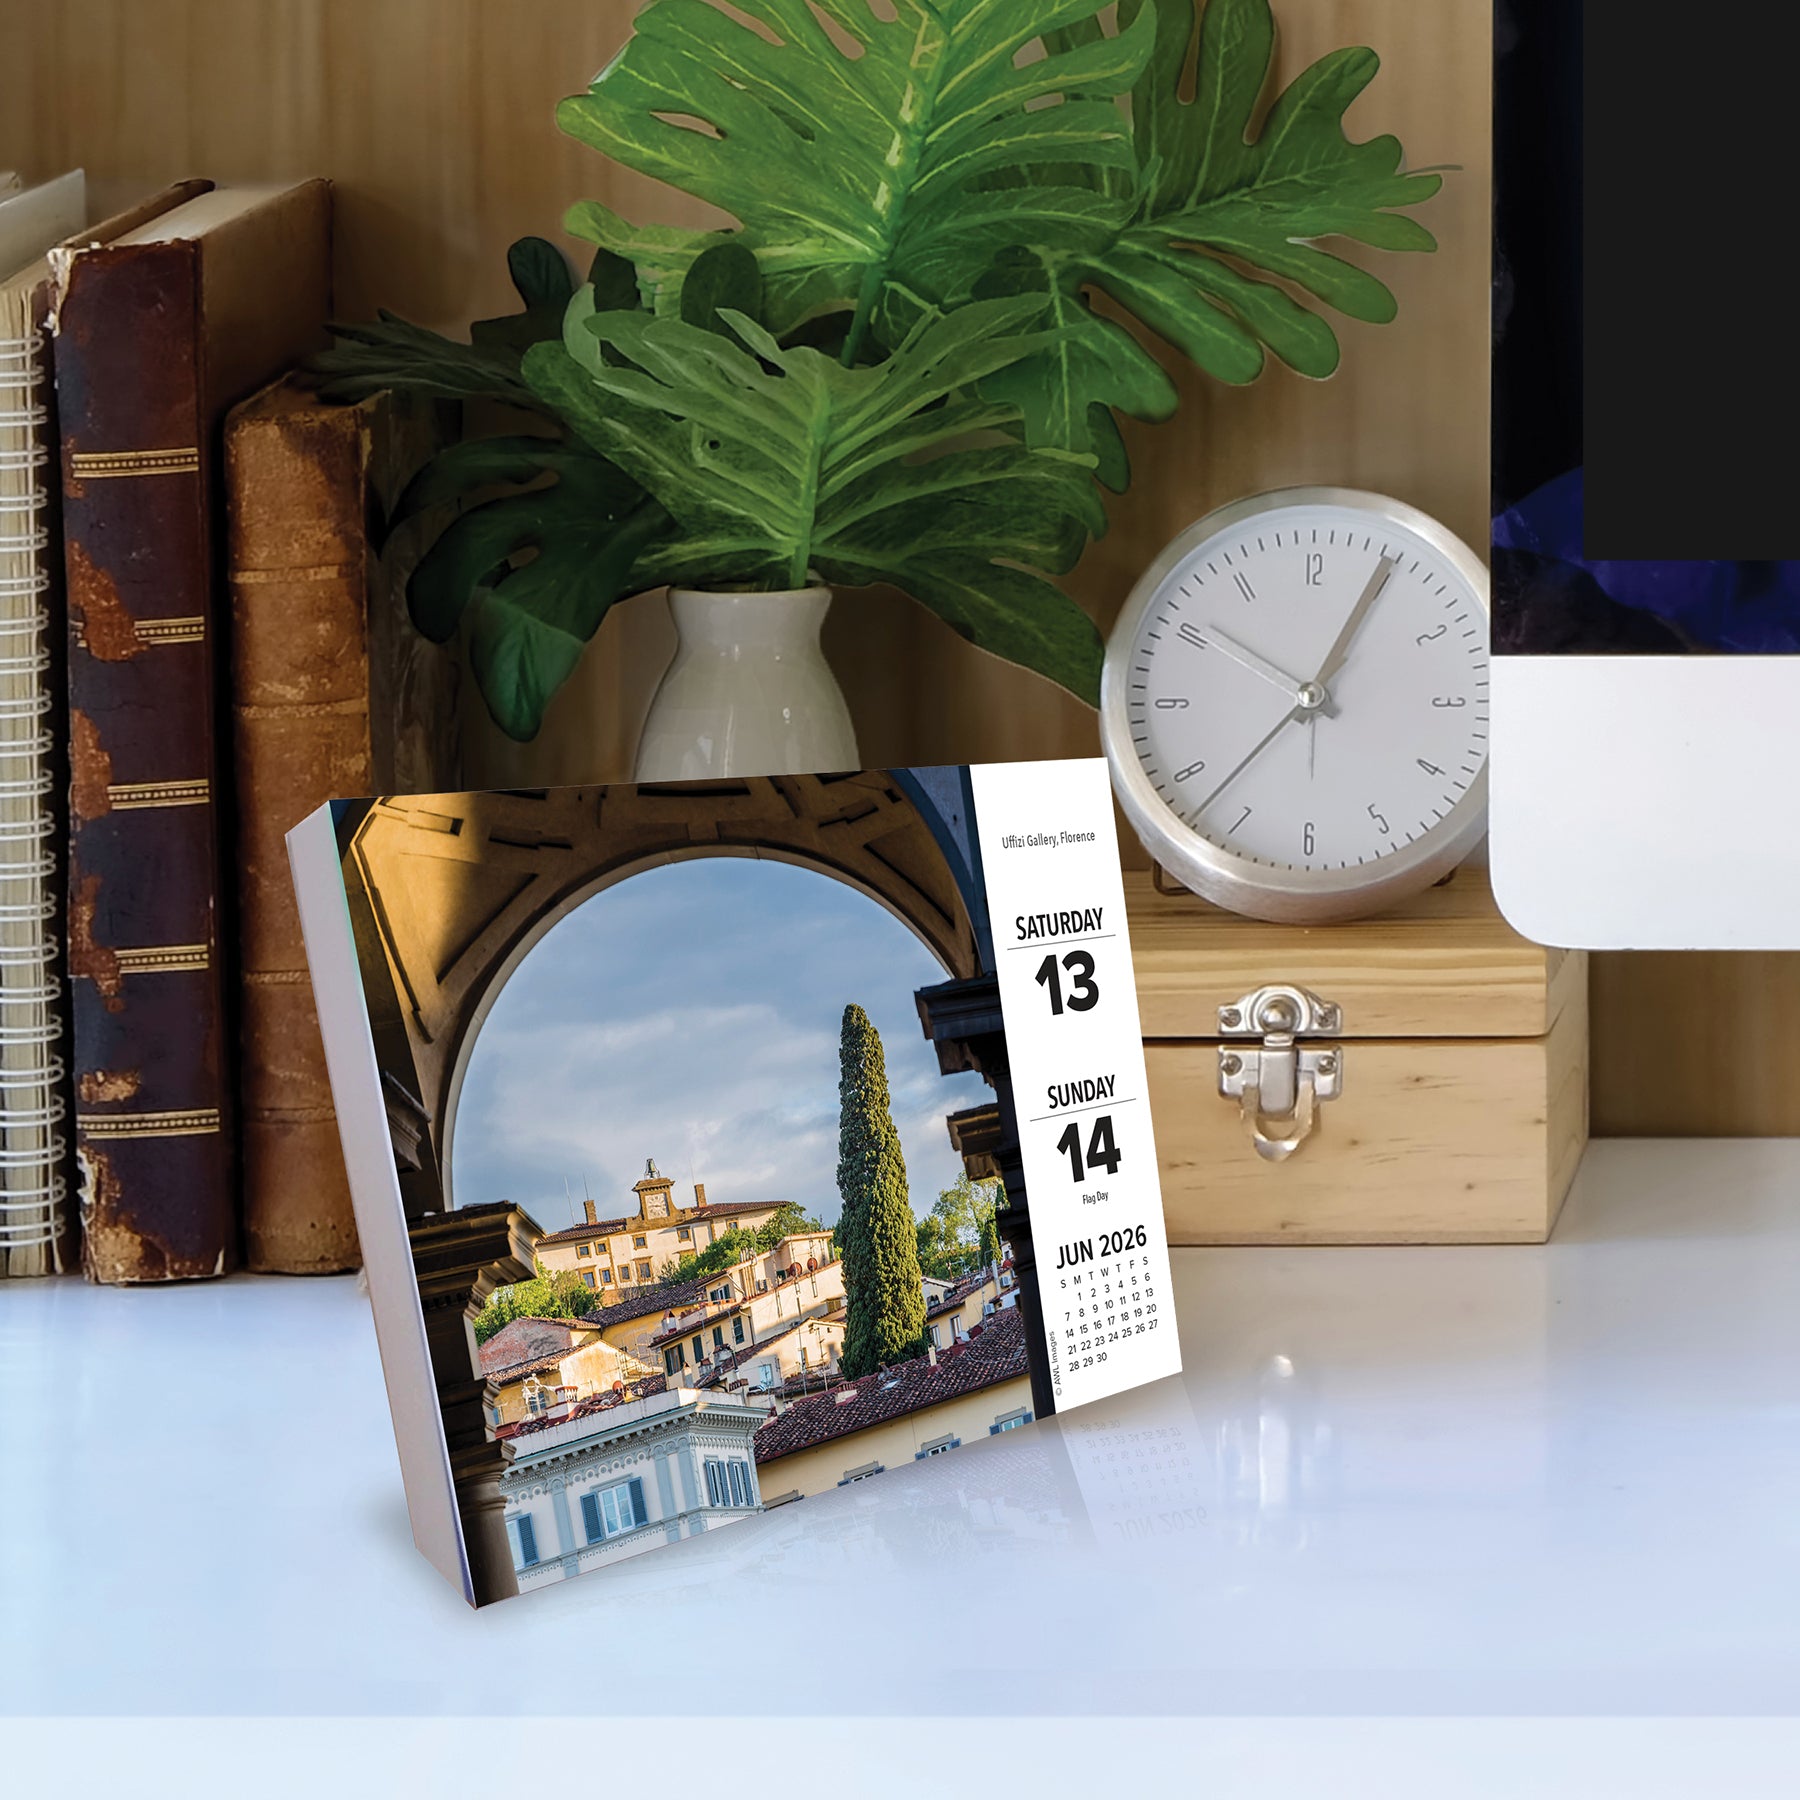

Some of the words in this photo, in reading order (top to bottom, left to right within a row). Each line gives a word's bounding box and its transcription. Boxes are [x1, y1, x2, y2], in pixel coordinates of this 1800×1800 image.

[1305, 553, 1323, 586] 12
[1232, 571, 1256, 603] 11
[1415, 624, 1448, 647] 2
[1154, 698, 1190, 709] 9
[1431, 696, 1467, 708] 3
[1173, 760, 1206, 784] 8
[1415, 758, 1447, 776] 4
[1227, 806, 1252, 836] 7
[1366, 803, 1390, 835] 5
[1001, 834, 1025, 849] Uffizi
[1026, 833, 1059, 849] Gallery,
[1059, 831, 1096, 844] Florence
[1303, 822, 1315, 857] 6
[1015, 906, 1104, 941] SATURDAY
[1034, 949, 1100, 1016] 13
[1047, 1073, 1116, 1110] SUNDAY
[1056, 1114, 1122, 1183] 14
[1082, 1194, 1097, 1205] Flag
[1096, 1190, 1109, 1202] Day
[1056, 1238, 1094, 1270] JUN
[1098, 1224, 1147, 1258] 2026
[1060, 1279, 1067, 1289] S
[1073, 1274, 1082, 1285] M
[1088, 1270, 1094, 1281] T
[1100, 1266, 1109, 1278] W
[1115, 1263, 1121, 1273] T
[1129, 1259, 1135, 1270] F
[1142, 1256, 1149, 1266] S
[1077, 1291, 1082, 1301] 1
[1090, 1287, 1097, 1298] 2
[1104, 1283, 1111, 1294] 3
[1117, 1279, 1124, 1289] 4
[1131, 1275, 1138, 1286] 5
[1144, 1272, 1151, 1282] 6
[1064, 1311, 1071, 1322] 7
[1078, 1307, 1085, 1318] 8
[1092, 1303, 1099, 1314] 9
[1104, 1299, 1114, 1310] 10
[1119, 1295, 1127, 1305] 11
[1131, 1291, 1141, 1302] 12
[1145, 1287, 1154, 1298] 13
[1065, 1328, 1075, 1339] 14
[1079, 1323, 1089, 1335] 15
[1093, 1319, 1103, 1330] 16
[1107, 1315, 1116, 1326] 17
[1120, 1311, 1130, 1322] 18
[1133, 1307, 1143, 1318] 19
[1146, 1303, 1157, 1315] 20
[1067, 1344, 1077, 1356] 21
[1080, 1339, 1092, 1351] 22
[1094, 1335, 1106, 1347] 23
[1107, 1331, 1119, 1343] 24
[1121, 1326, 1133, 1339] 25
[1135, 1322, 1146, 1334] 26
[1148, 1318, 1158, 1330] 27
[1048, 1330, 1059, 1364] Images
[1068, 1360, 1080, 1372] 28
[1082, 1356, 1094, 1368] 29
[1096, 1351, 1108, 1363] 30
[1052, 1364, 1062, 1386] AWL
